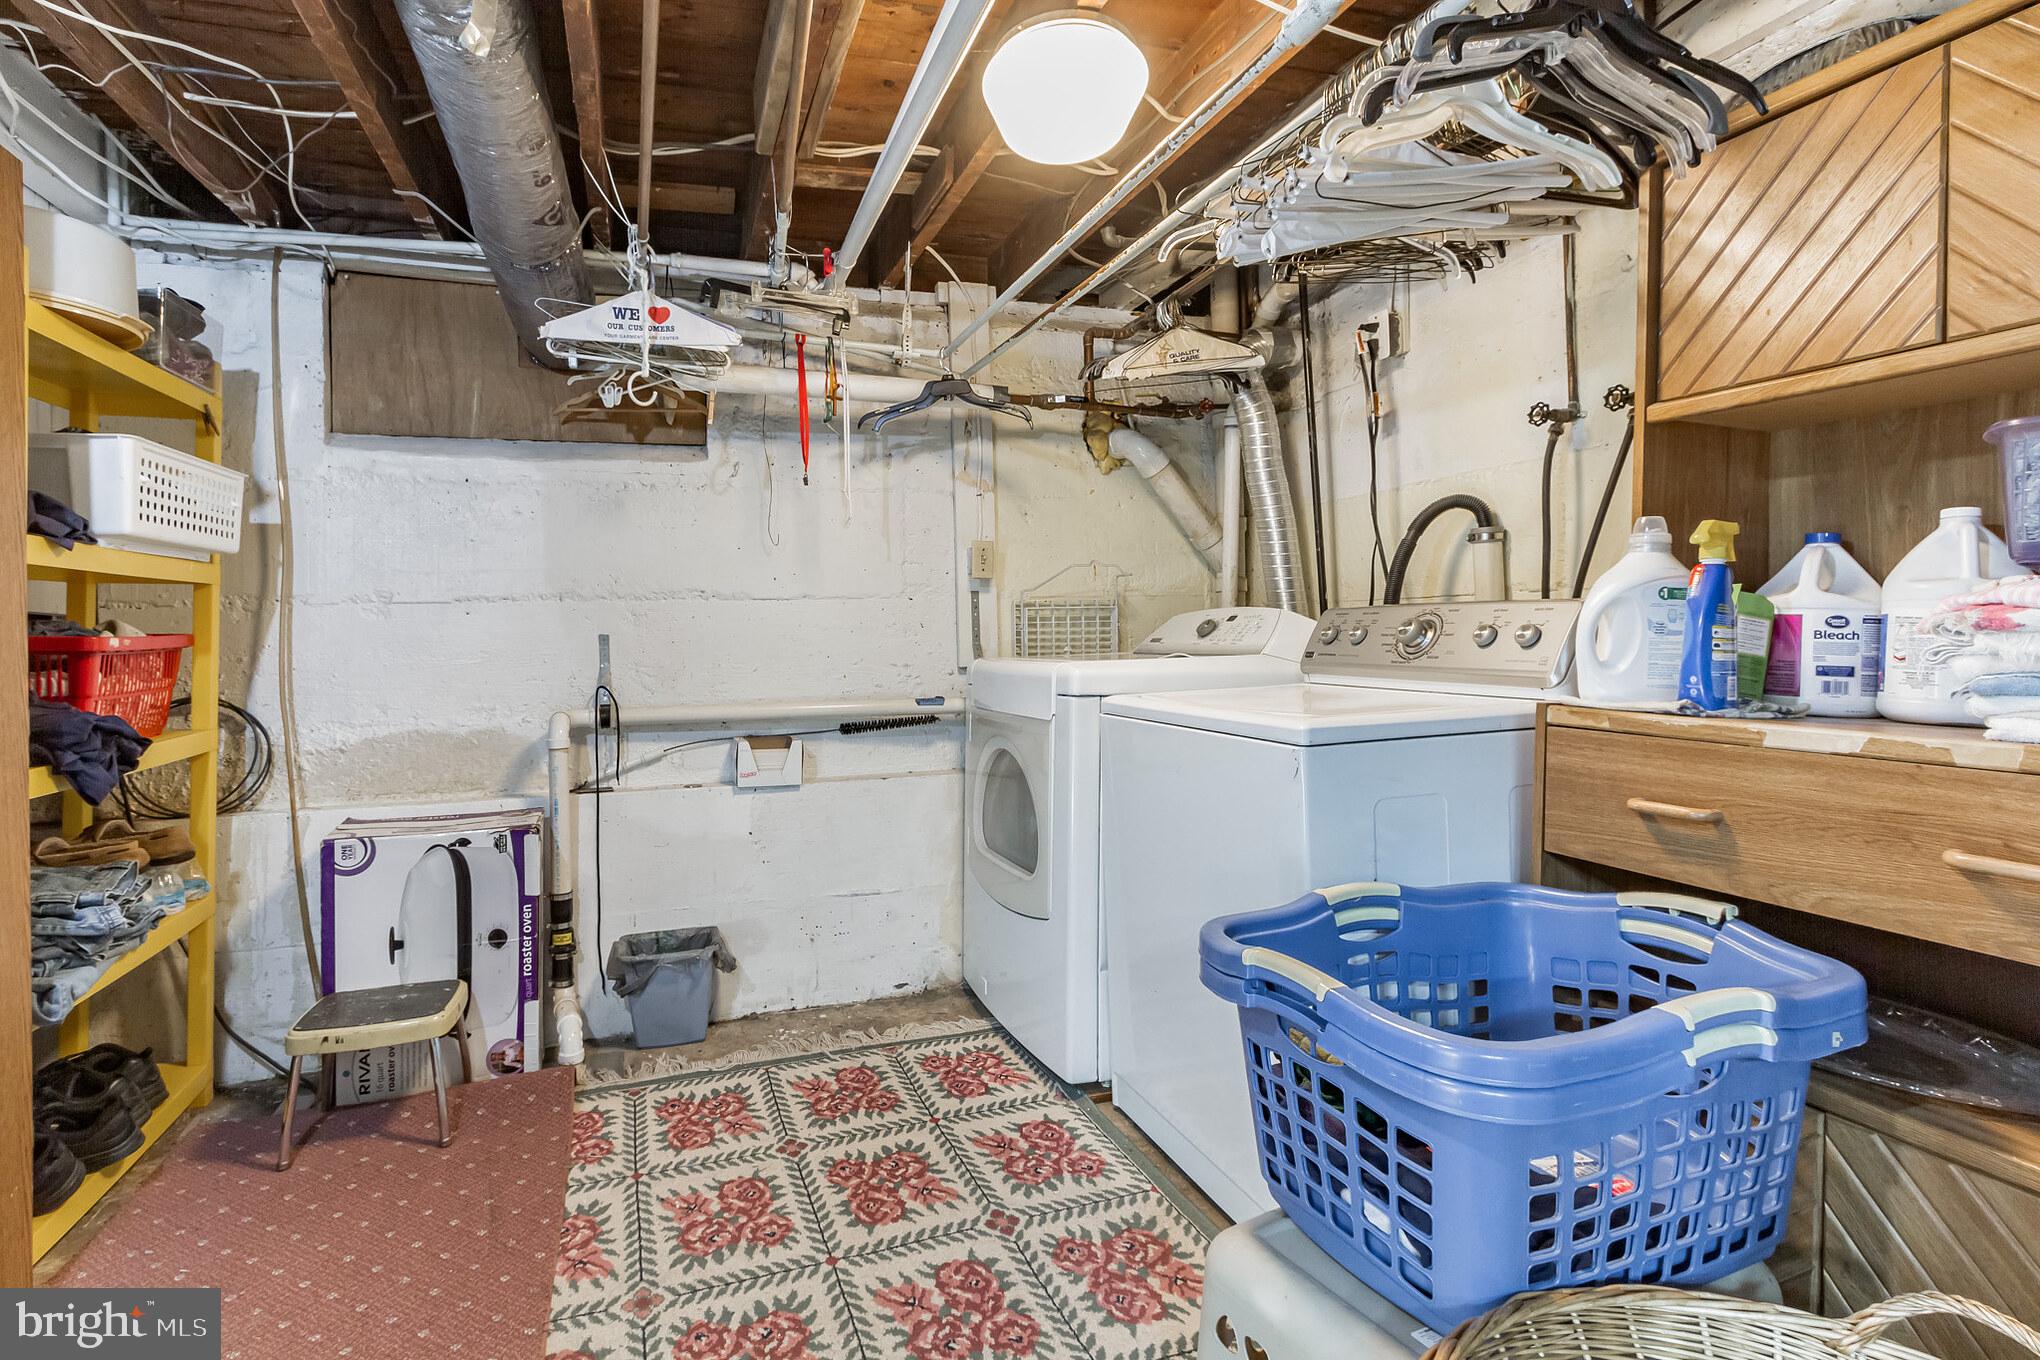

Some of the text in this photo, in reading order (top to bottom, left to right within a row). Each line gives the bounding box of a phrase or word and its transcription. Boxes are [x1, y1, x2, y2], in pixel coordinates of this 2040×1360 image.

[612, 307, 640, 320] WE
[607, 322, 675, 332] OUR CUSOMERS
[1169, 348, 1200, 359] QUALITY
[1813, 630, 1860, 641] Bleach
[521, 904, 535, 998] quart roaster oven
[377, 1062, 386, 1084] quart
[387, 1046, 396, 1092] roaster ov
